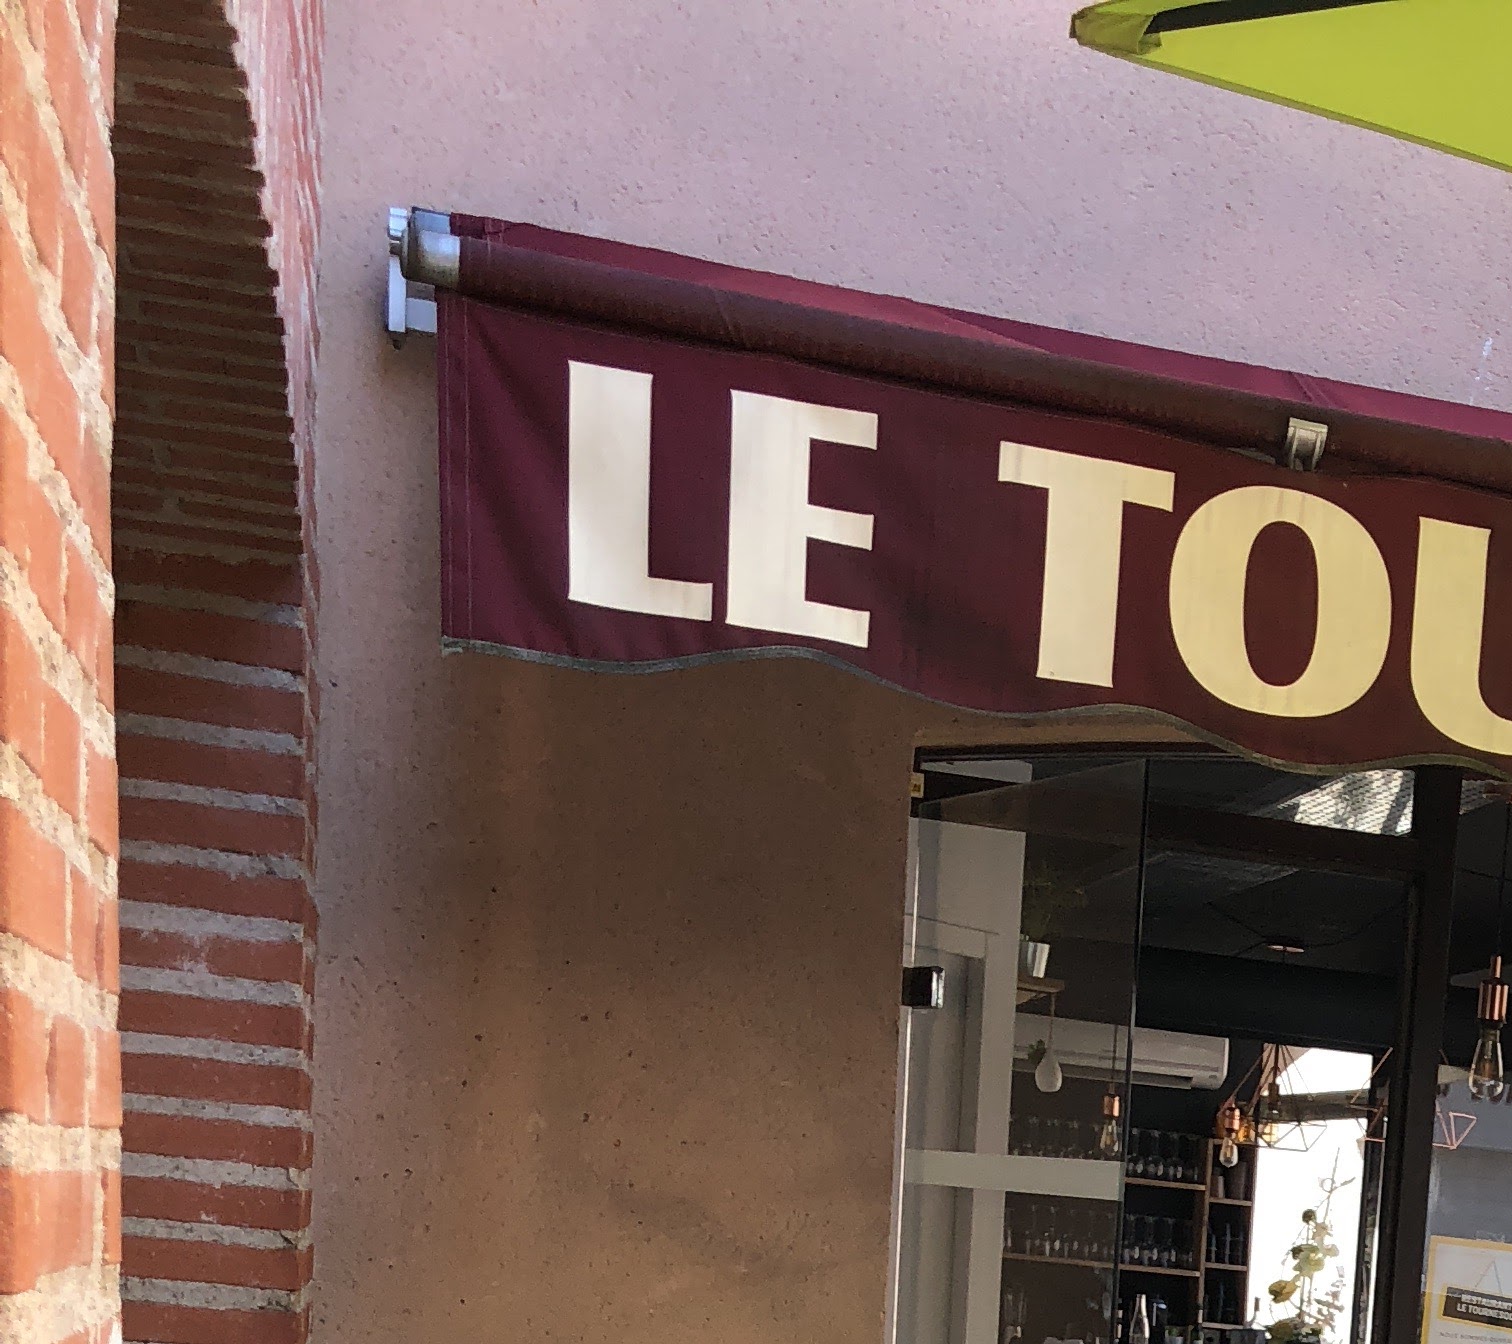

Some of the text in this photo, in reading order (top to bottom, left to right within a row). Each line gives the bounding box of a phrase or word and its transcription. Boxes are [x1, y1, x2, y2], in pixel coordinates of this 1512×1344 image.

[567, 359, 879, 648] LE
[1457, 1304, 1466, 1312] LE
[1461, 1294, 1512, 1310] RESTAURANT
